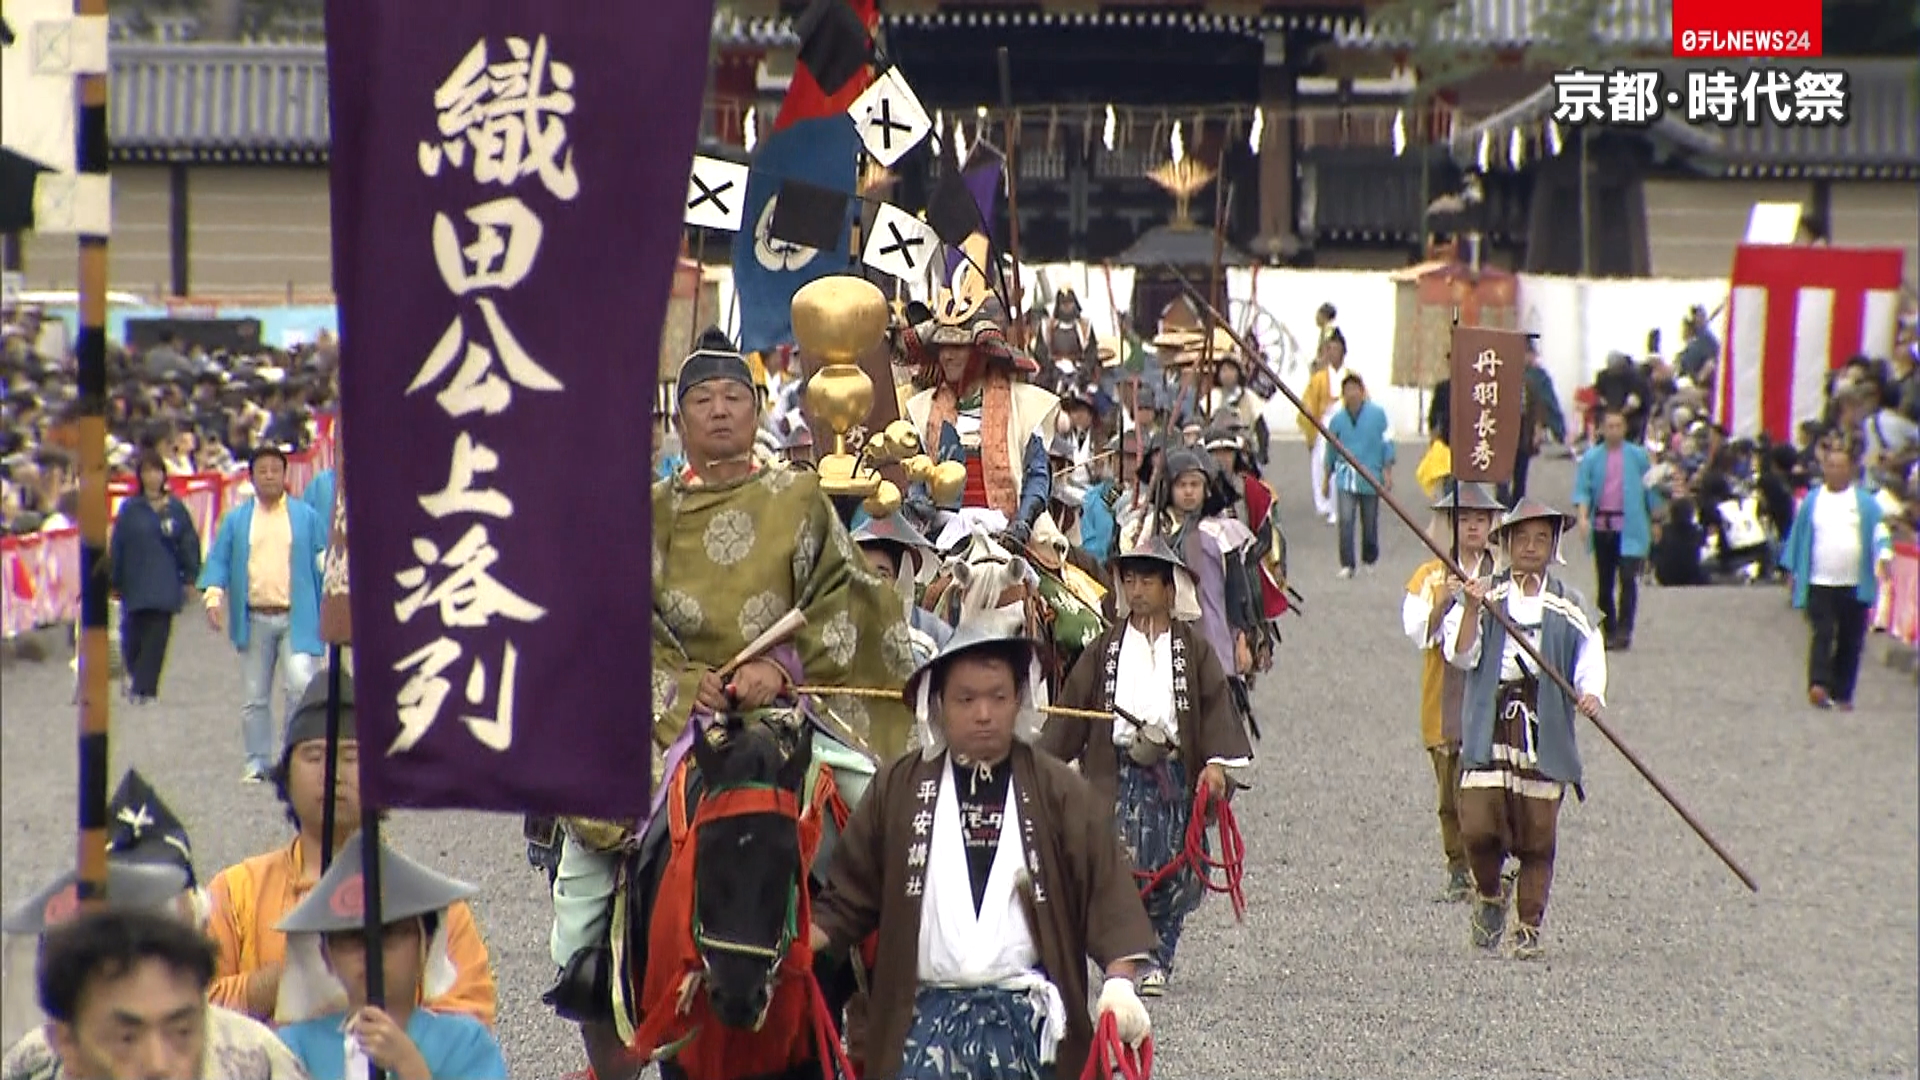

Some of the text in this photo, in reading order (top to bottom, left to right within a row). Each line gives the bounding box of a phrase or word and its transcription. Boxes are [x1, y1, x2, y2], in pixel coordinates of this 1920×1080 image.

[386, 34, 580, 756] 織田公上洛列
[1471, 348, 1503, 471] 丹羽長秀
